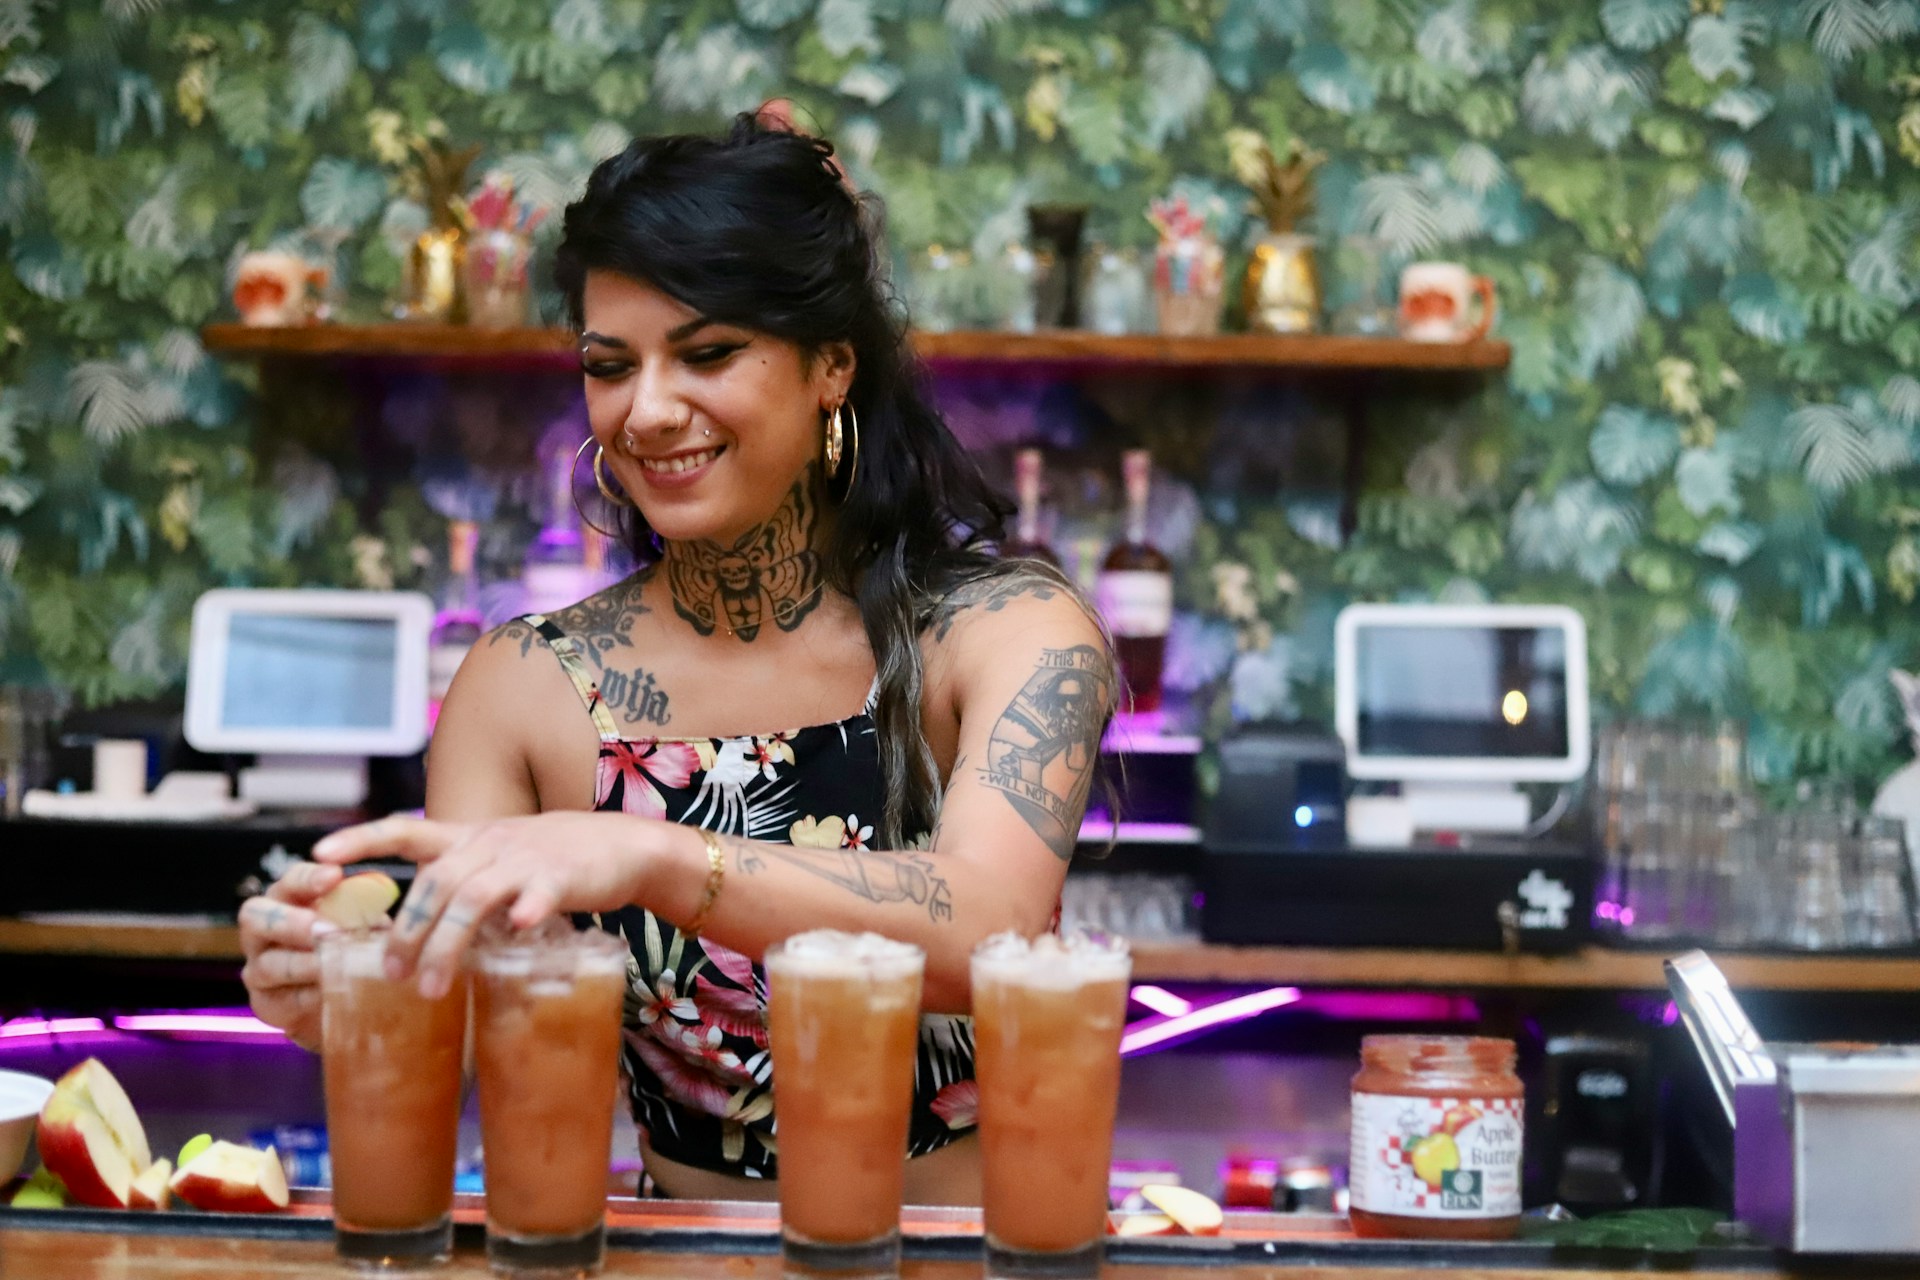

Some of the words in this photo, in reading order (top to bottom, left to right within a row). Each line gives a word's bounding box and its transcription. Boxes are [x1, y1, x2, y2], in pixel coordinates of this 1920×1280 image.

[600, 667, 671, 727] mija
[1025, 784, 1049, 806] NOT
[1475, 1122, 1516, 1147] Apple
[1471, 1146, 1518, 1167] Butter
[1441, 1191, 1482, 1209] EDEN
